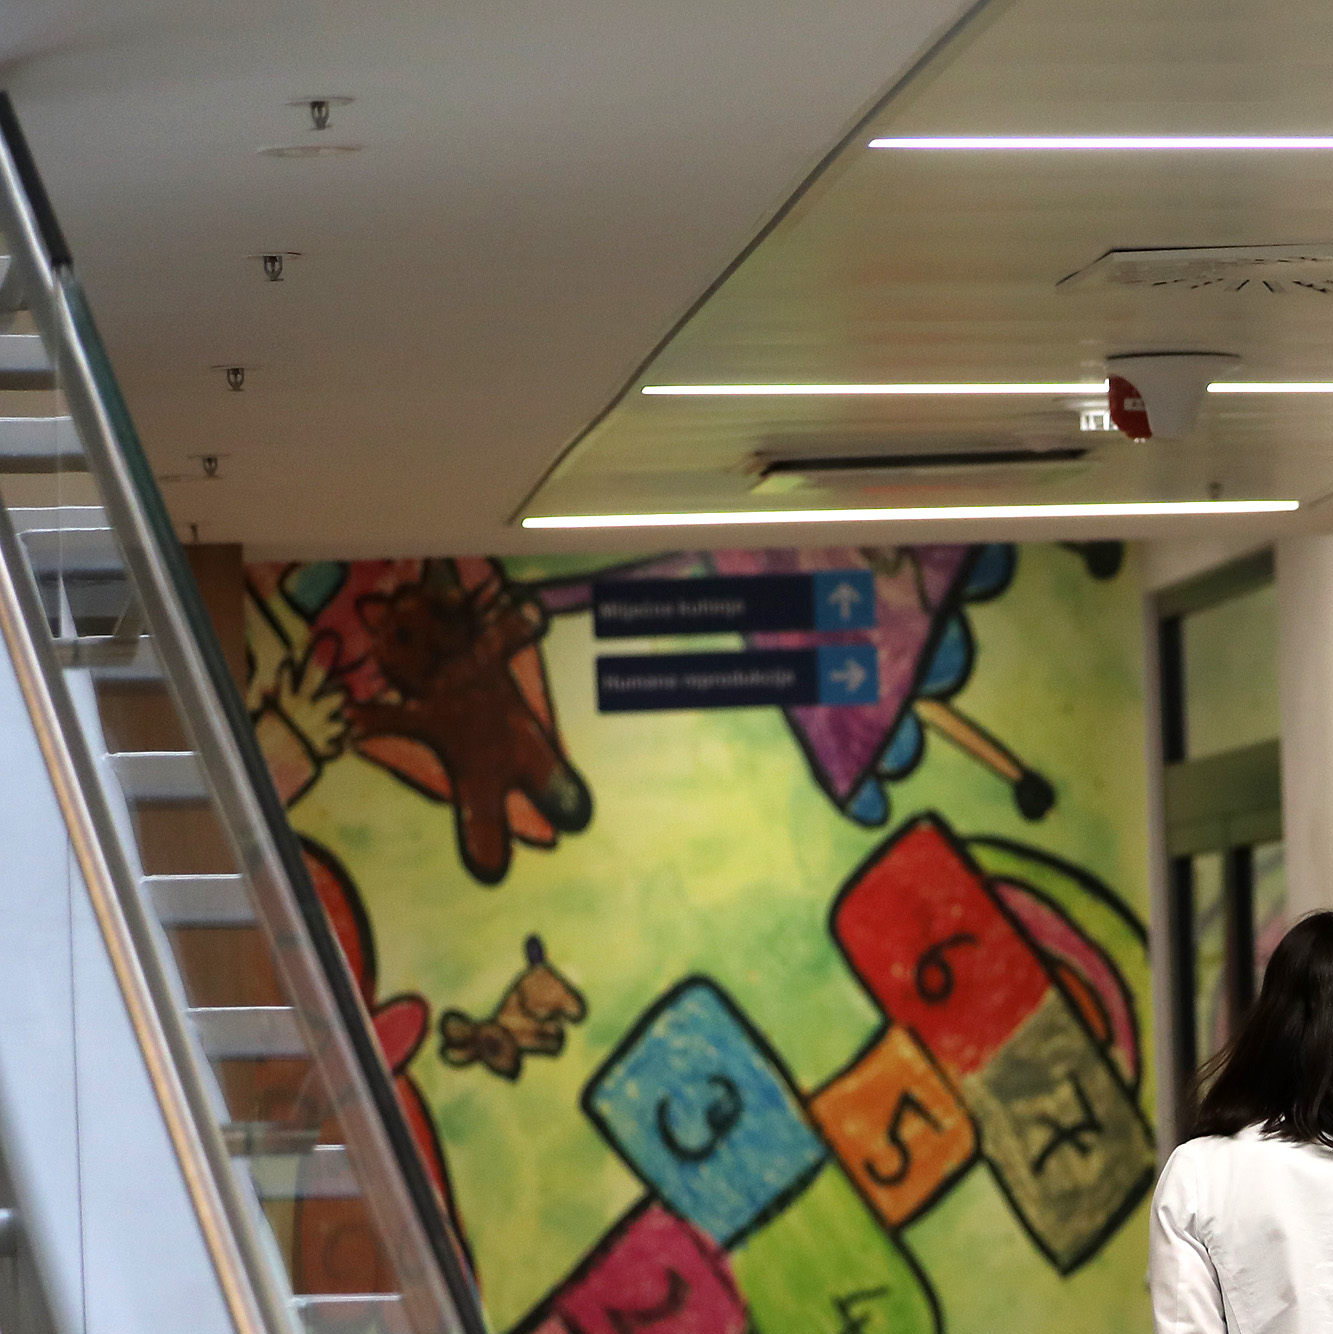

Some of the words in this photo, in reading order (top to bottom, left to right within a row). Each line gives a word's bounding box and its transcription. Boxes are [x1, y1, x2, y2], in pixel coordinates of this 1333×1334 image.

[916, 932, 977, 1001] 6
[657, 1074, 744, 1164] 3
[864, 1090, 945, 1187] 5
